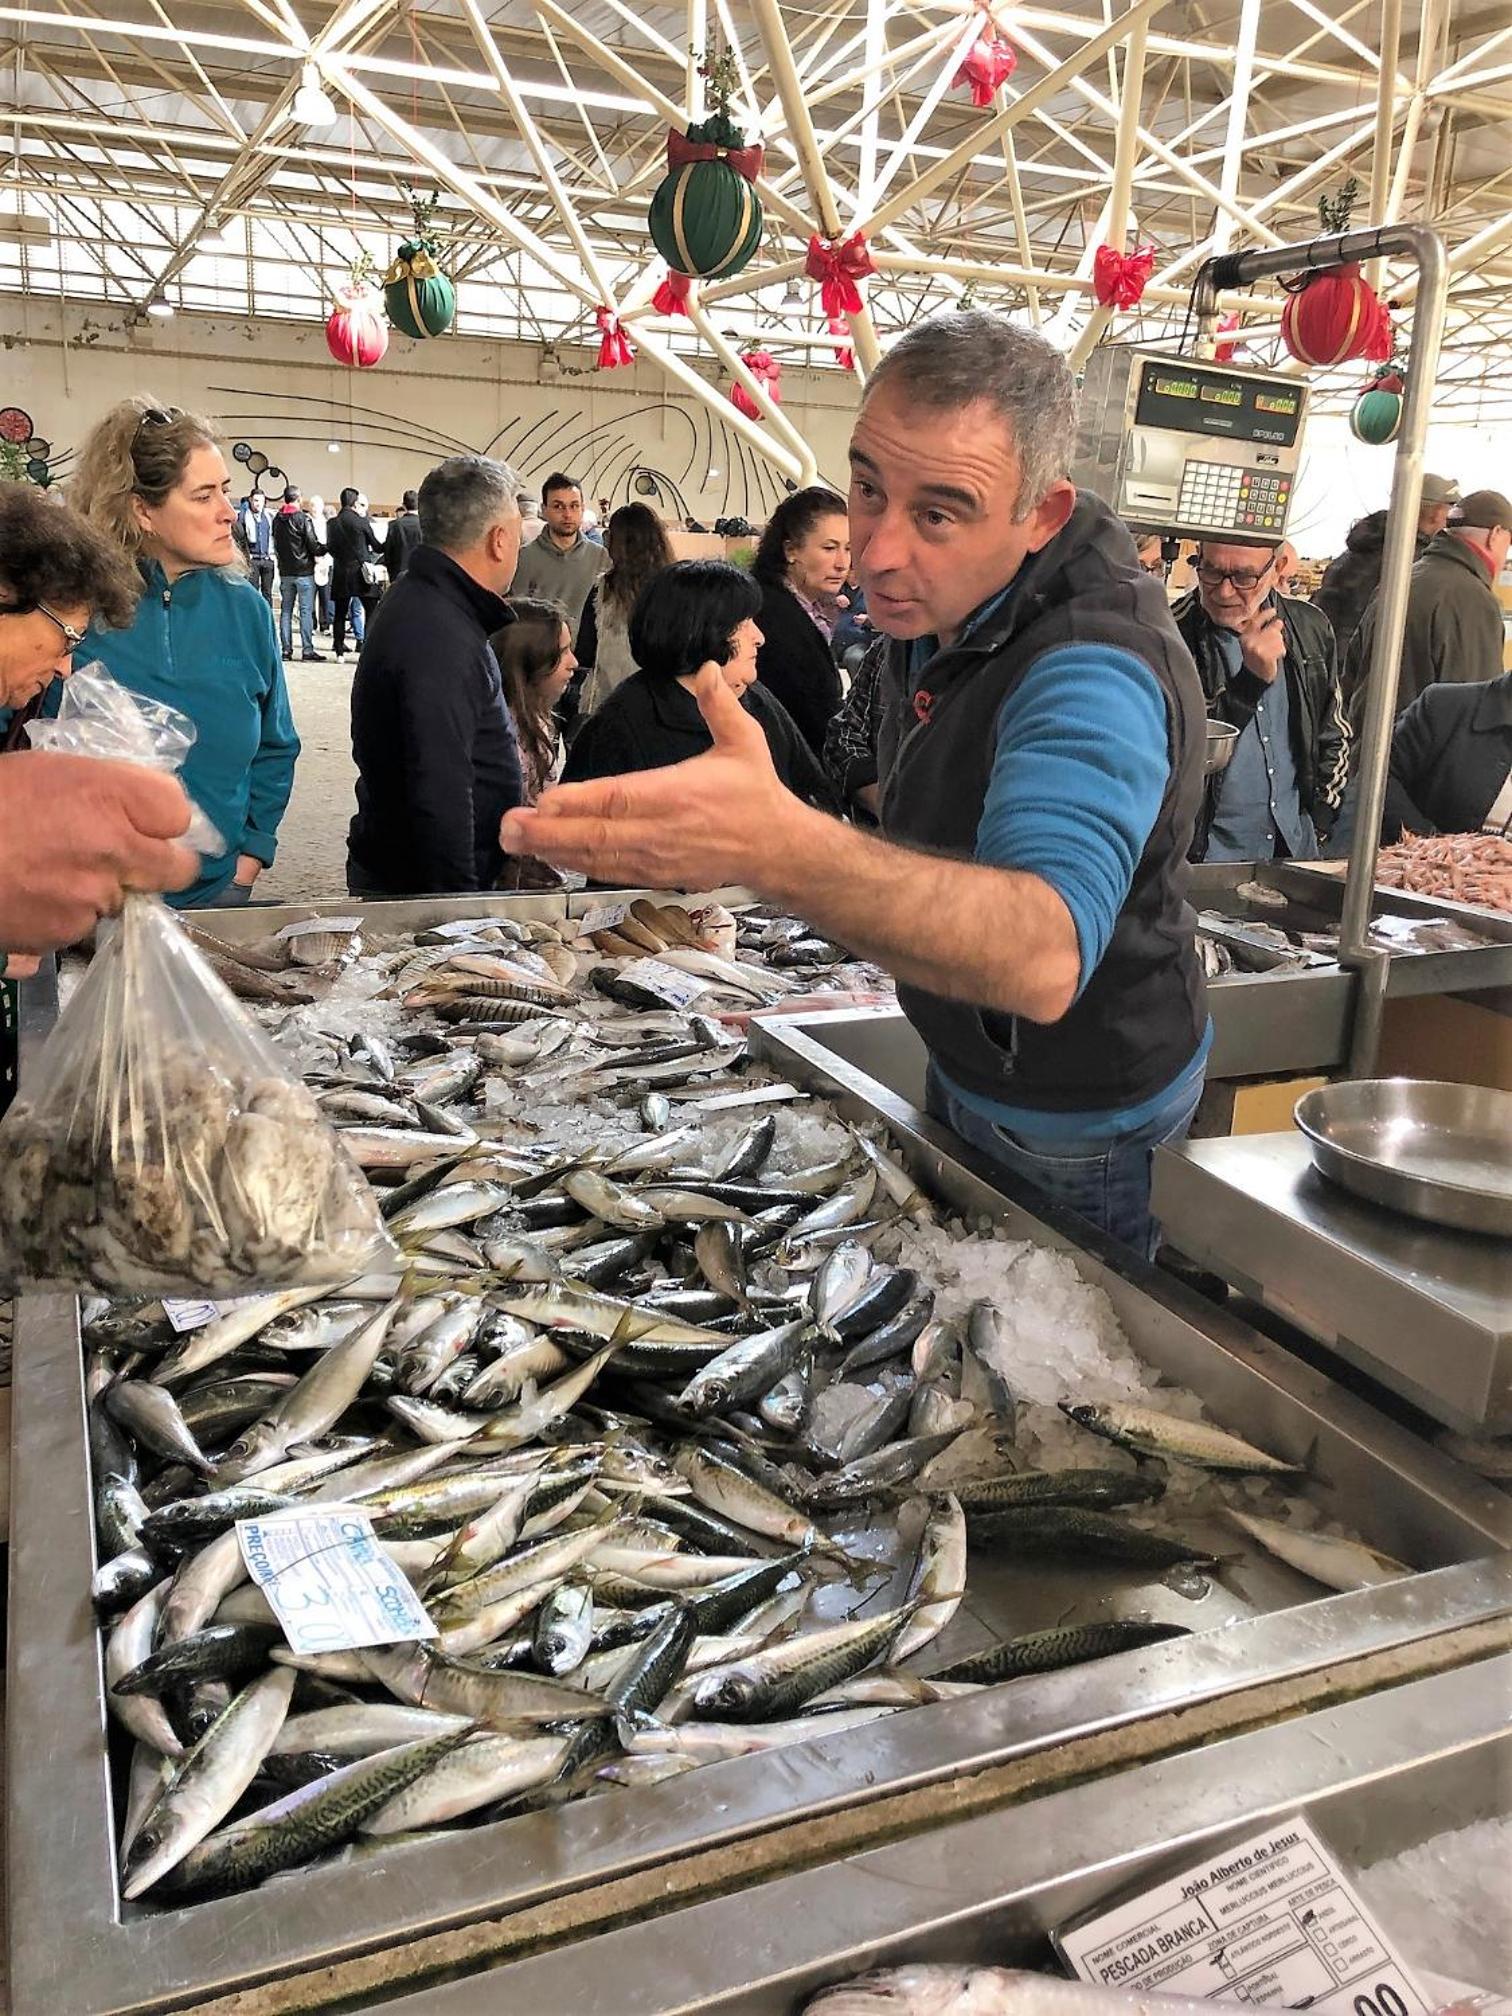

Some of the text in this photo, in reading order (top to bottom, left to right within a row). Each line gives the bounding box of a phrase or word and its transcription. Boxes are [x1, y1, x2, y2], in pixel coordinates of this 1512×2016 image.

[1180, 1832, 1300, 1901] João Alberto de Jesus
[1225, 1876, 1248, 1892] NOME
[1287, 1878, 1337, 1908] ARTE DE PESCA
[1091, 1924, 1161, 1965] NOME COMERCIAL
[1207, 1913, 1271, 1951] ZONA DE CAPTURA
[1099, 1917, 1210, 1986] PESCADA BRANCA
[1141, 1975, 1154, 1987] DE
[1152, 1954, 1195, 1981] PRODUÇÃO
